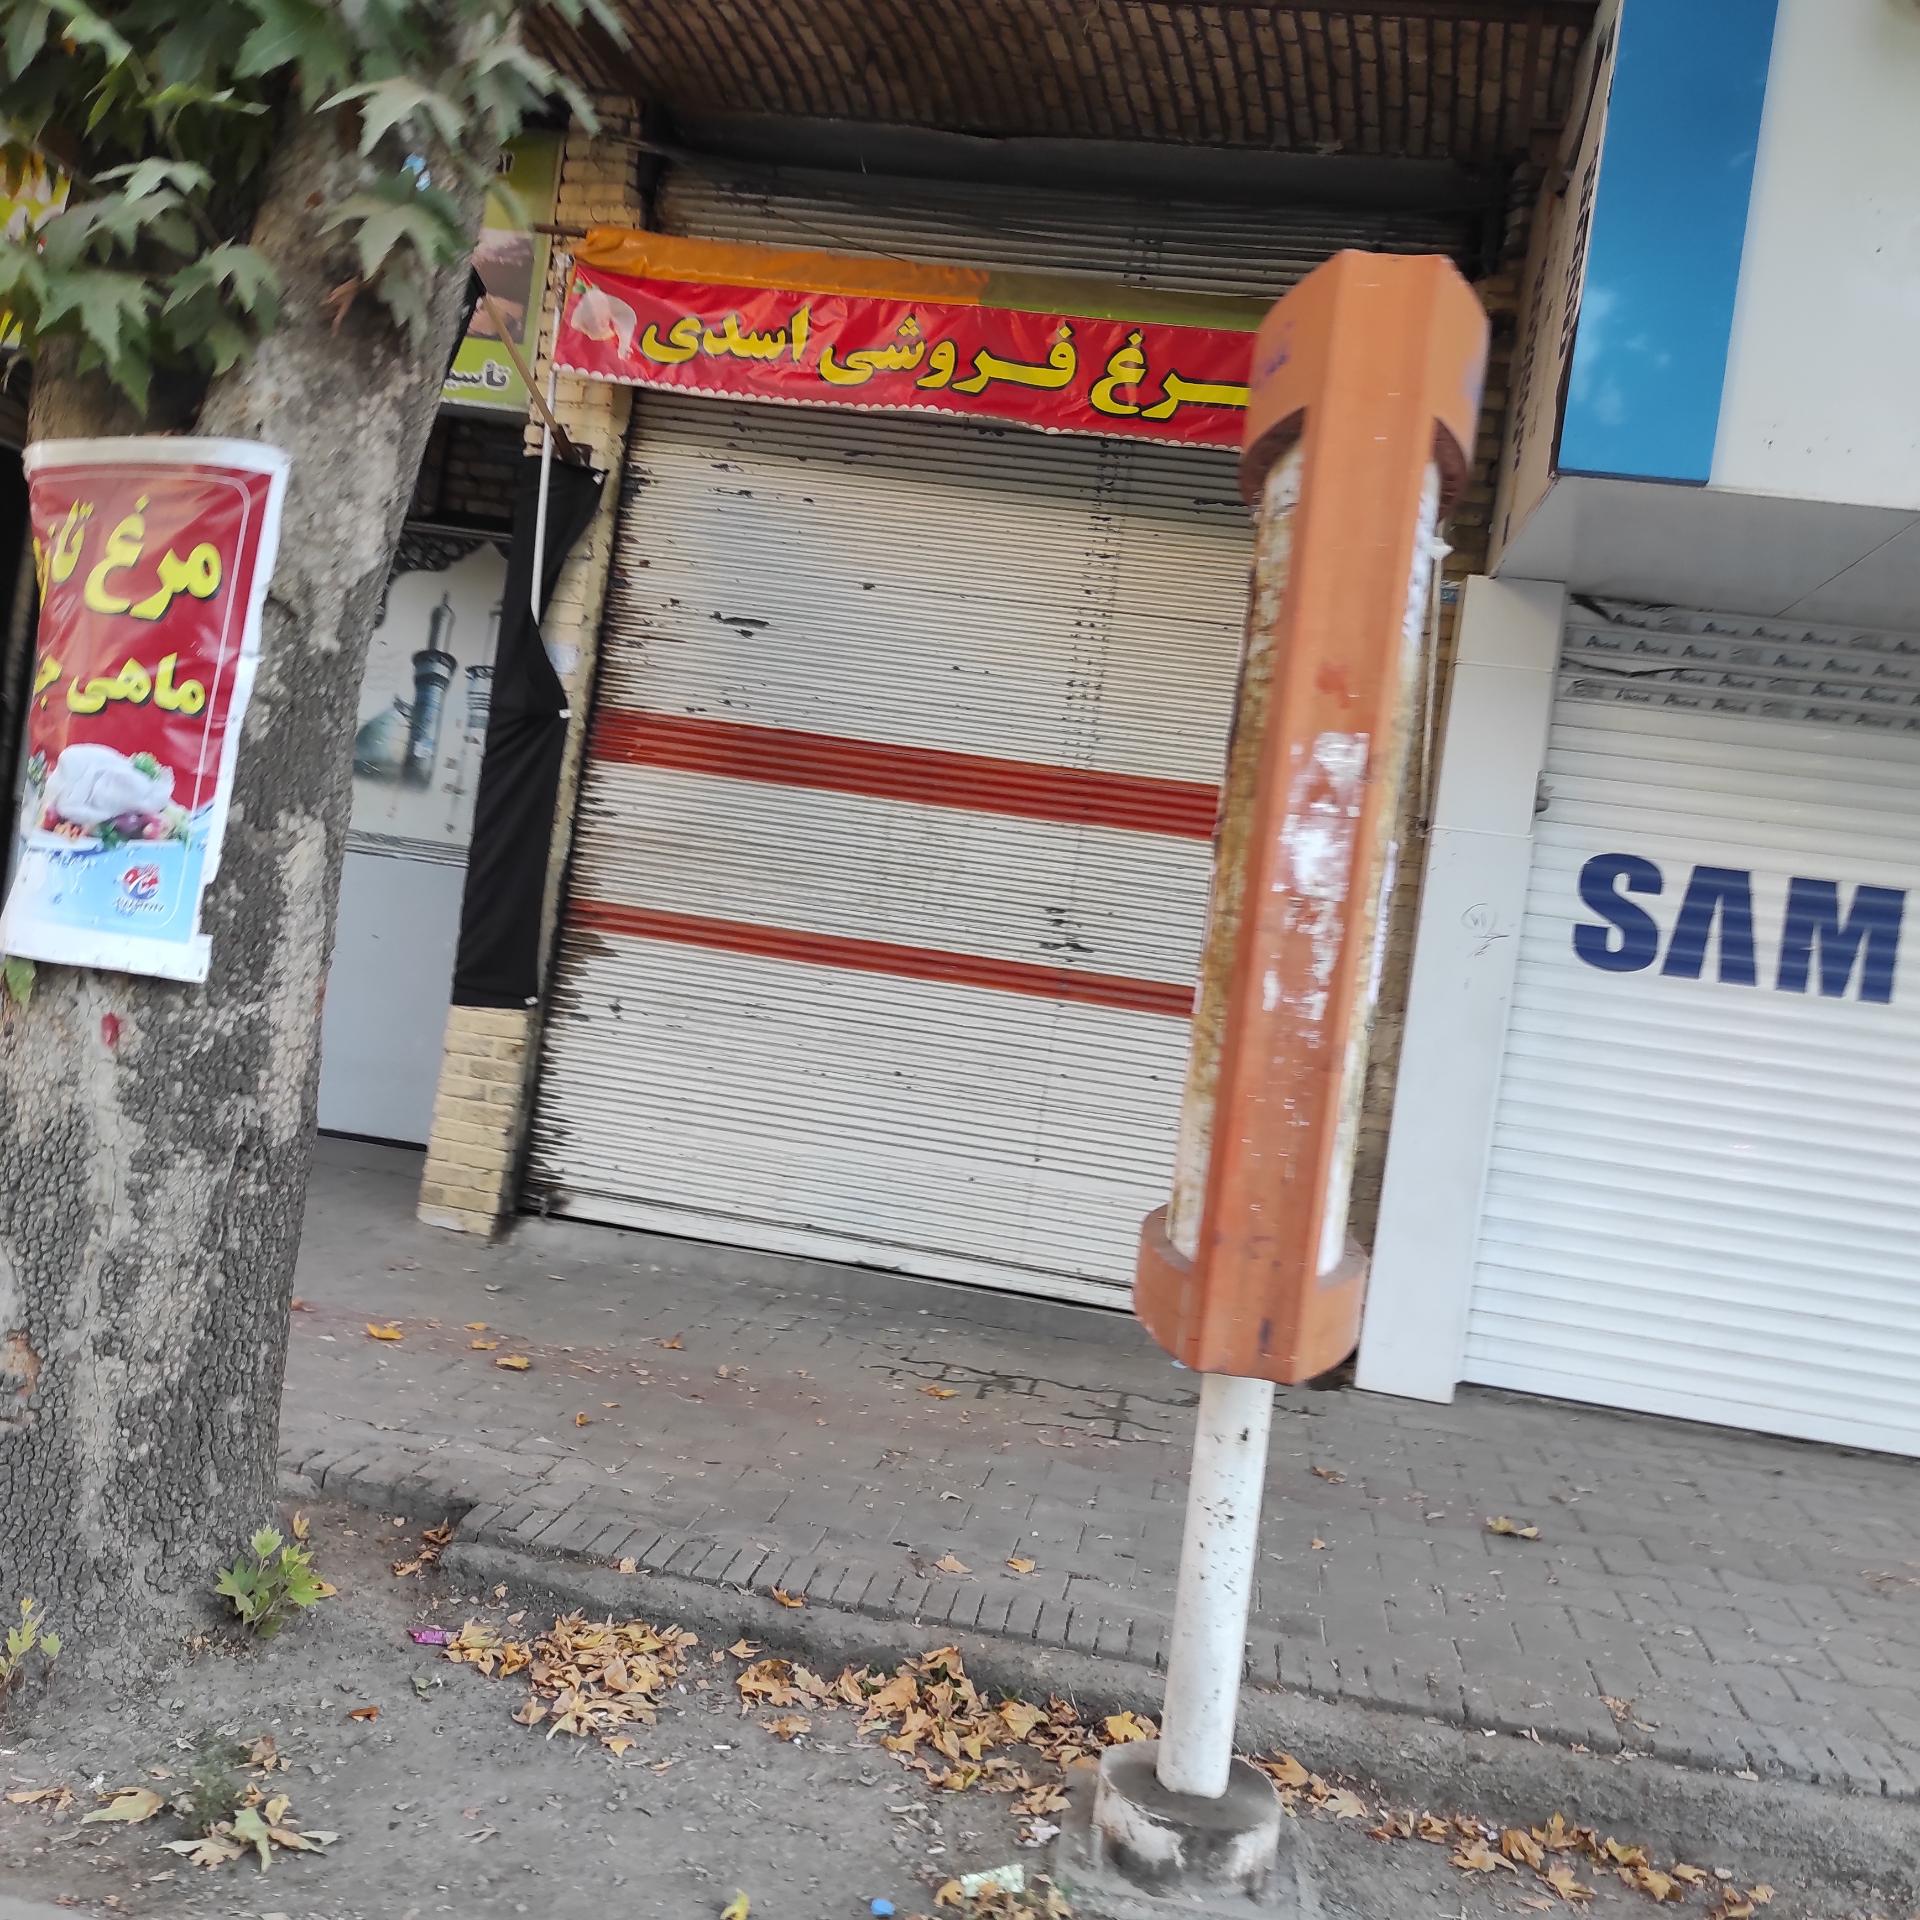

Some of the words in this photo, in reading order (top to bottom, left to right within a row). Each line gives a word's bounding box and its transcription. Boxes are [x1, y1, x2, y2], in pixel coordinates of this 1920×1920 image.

[641, 306, 809, 365] اسدی
[819, 313, 1077, 394] فروشی
[1088, 328, 1250, 421] رغ
[84, 494, 223, 621] مرغ
[66, 652, 206, 715] ماهی
[1573, 852, 1907, 1005] SAM
